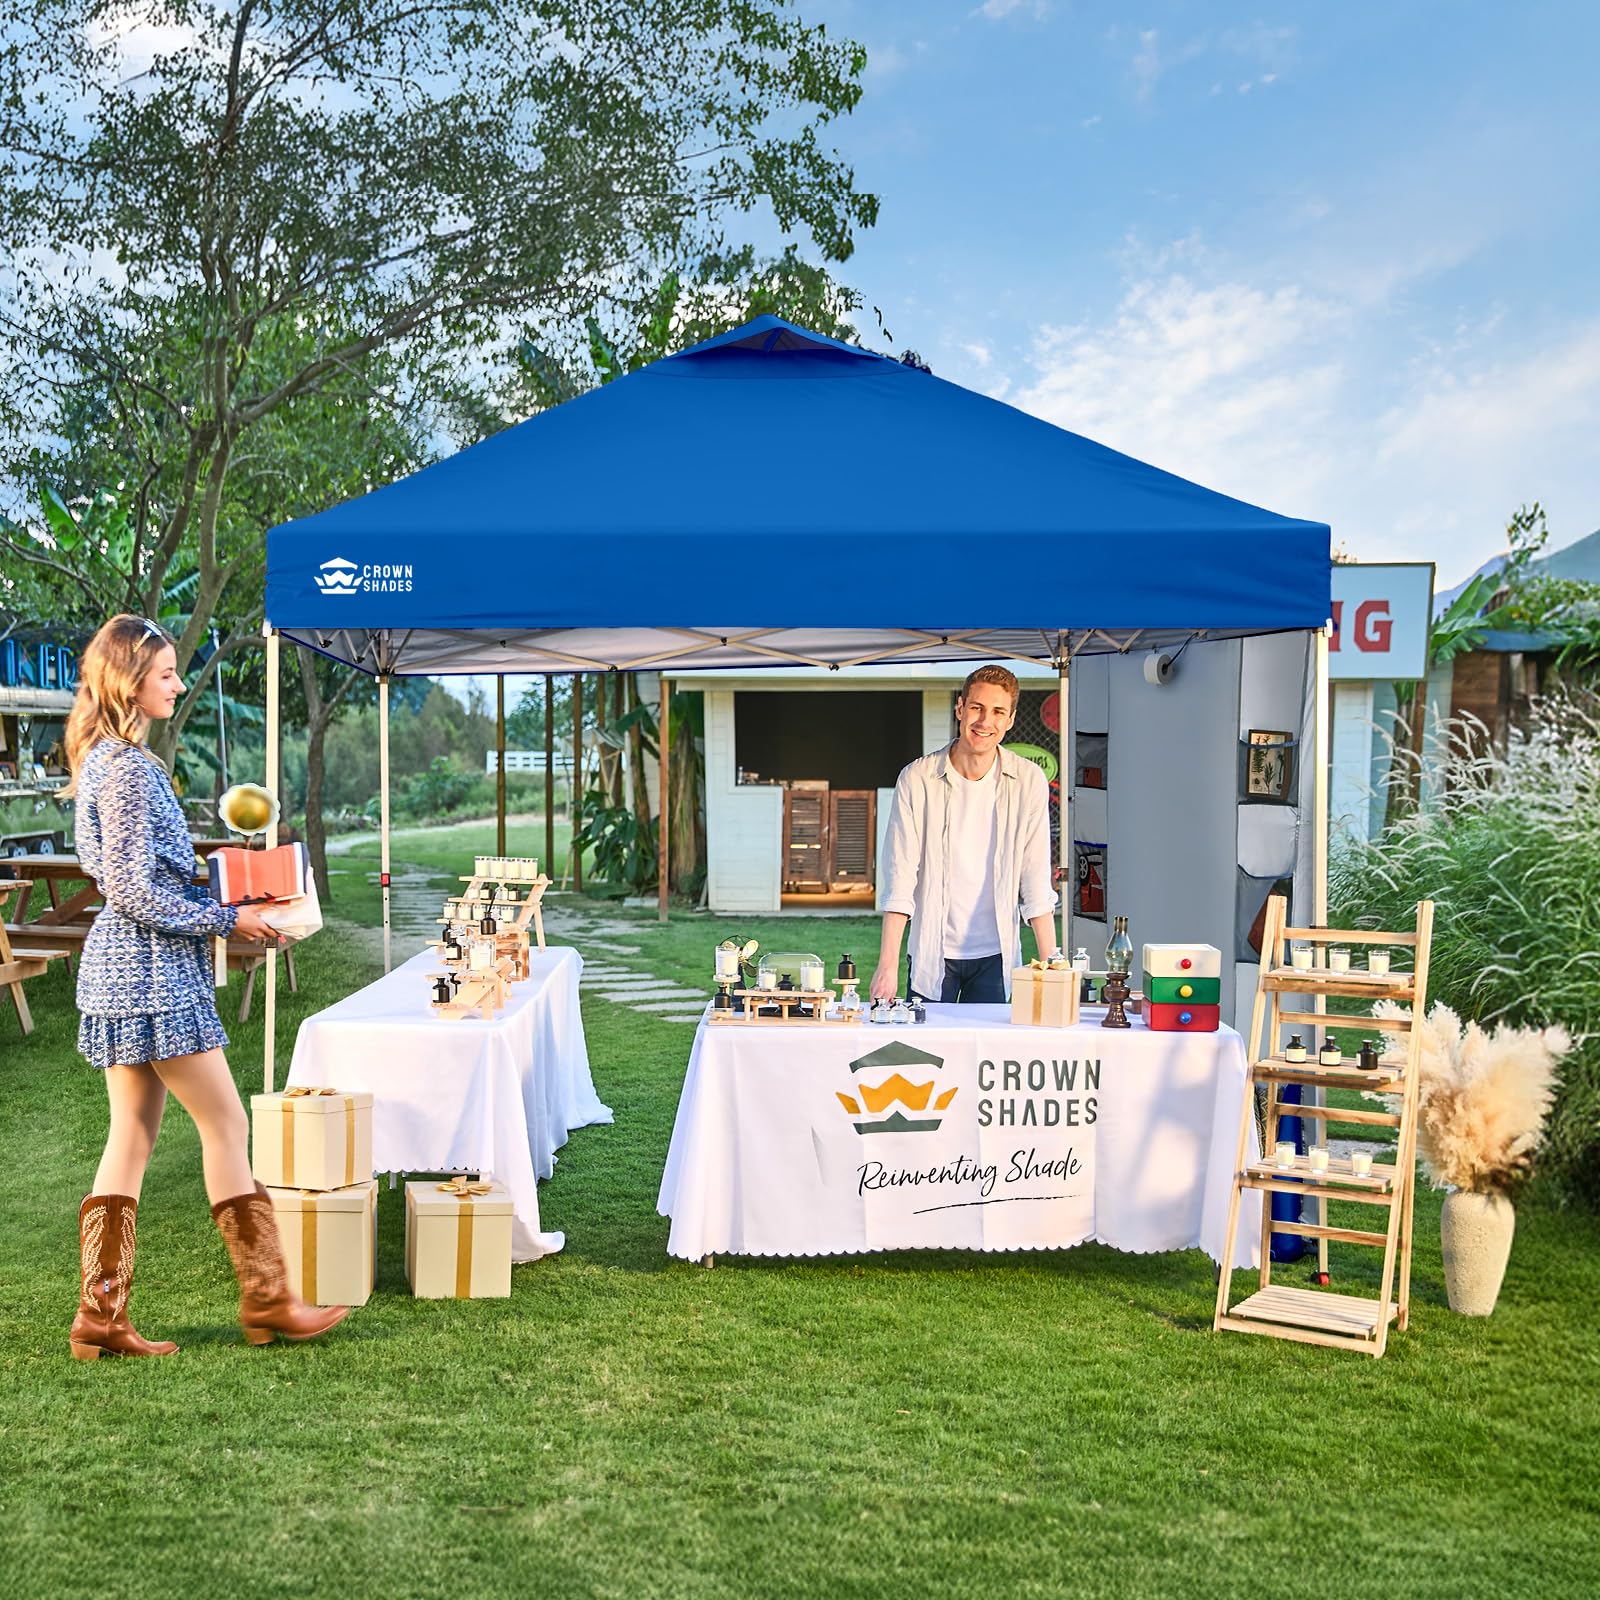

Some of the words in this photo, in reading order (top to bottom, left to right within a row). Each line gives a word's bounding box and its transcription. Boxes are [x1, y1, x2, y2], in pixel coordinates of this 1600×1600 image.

[363, 565, 413, 578] CROWN
[363, 580, 413, 592] SHADES
[977, 1059, 1101, 1092] CROWN
[977, 1097, 1098, 1127] SHADES
[856, 1154, 999, 1198] Reinventing
[1004, 1147, 1082, 1183] Shade
